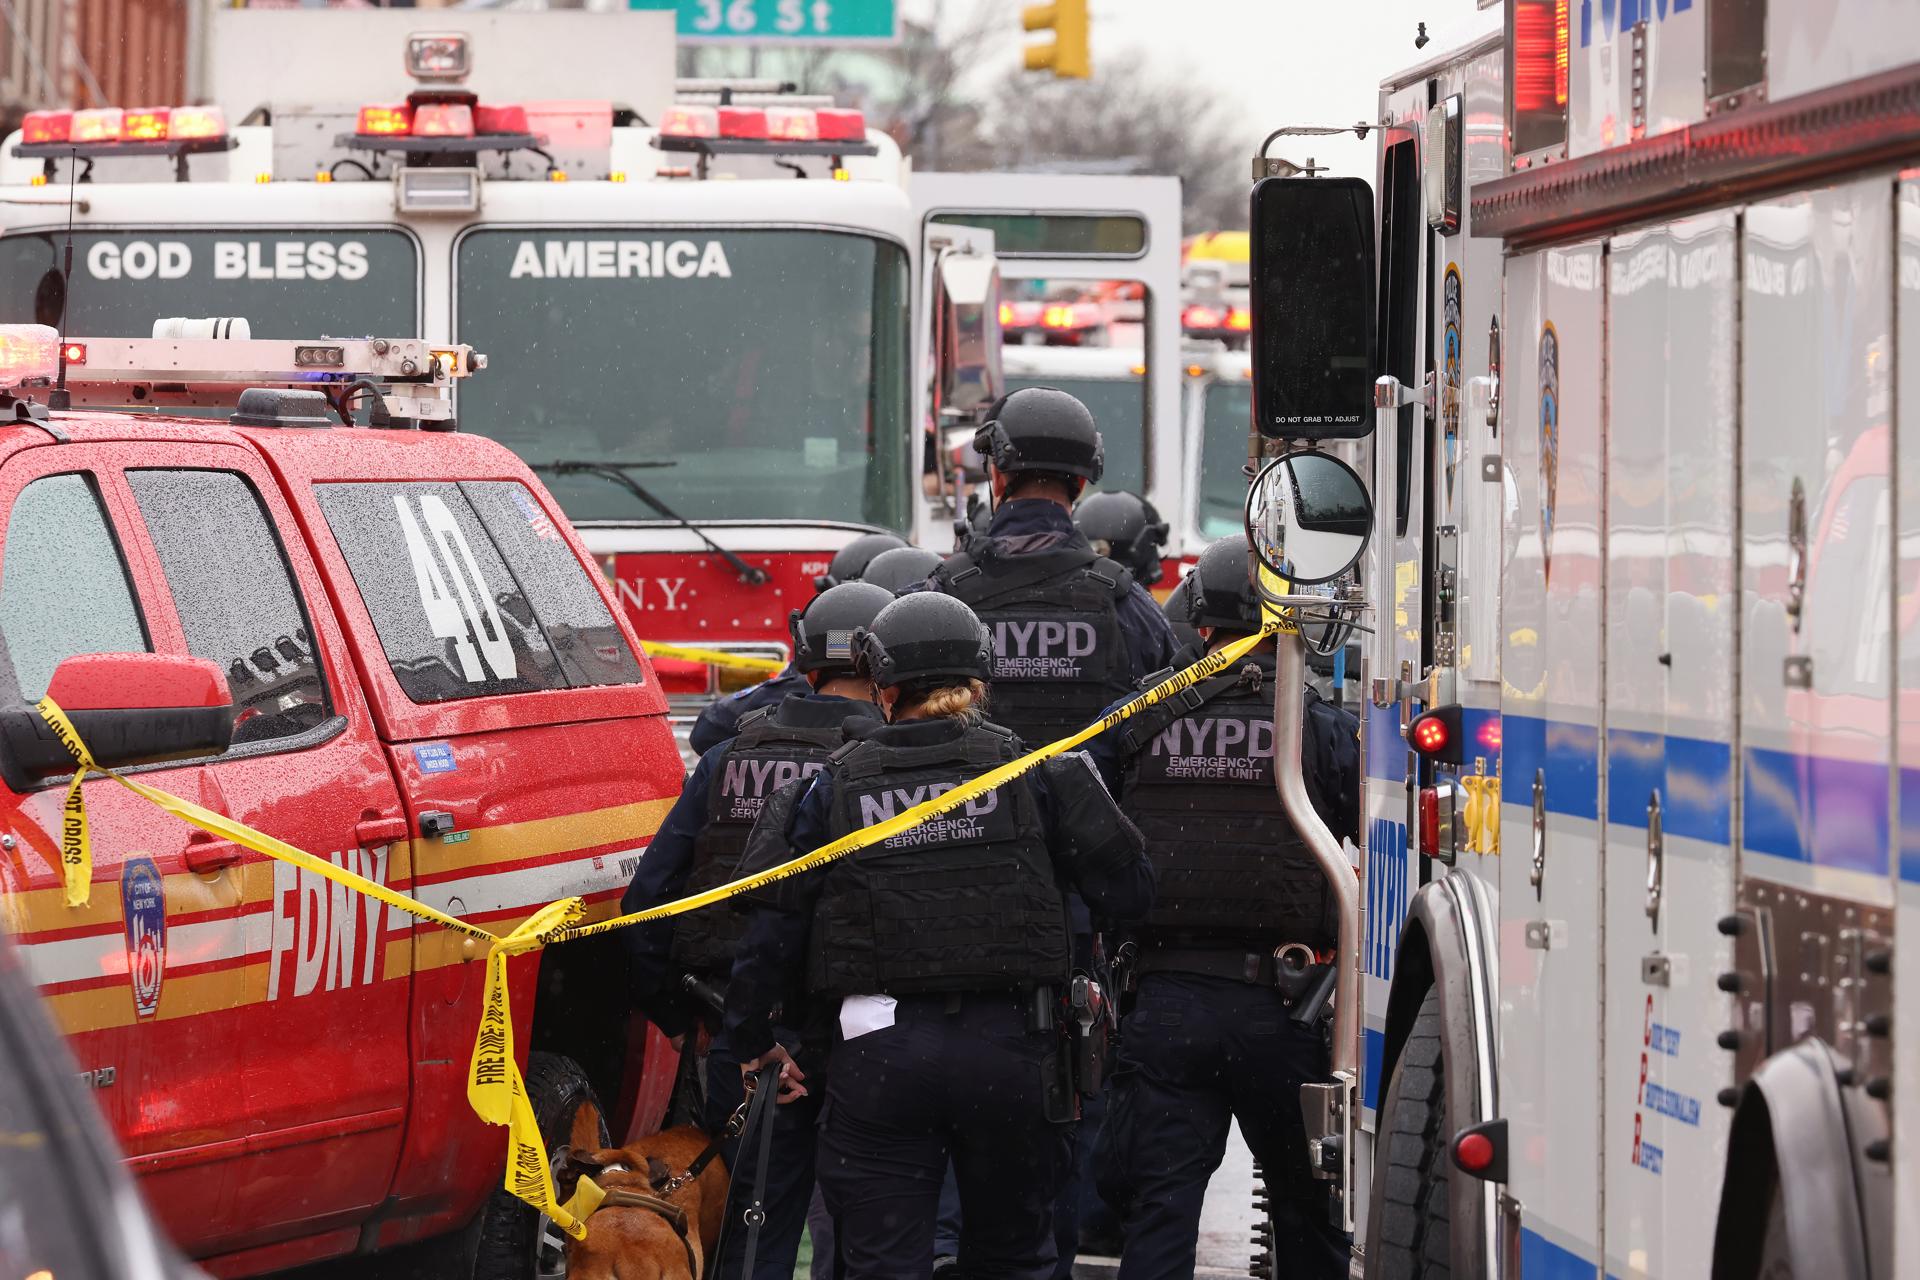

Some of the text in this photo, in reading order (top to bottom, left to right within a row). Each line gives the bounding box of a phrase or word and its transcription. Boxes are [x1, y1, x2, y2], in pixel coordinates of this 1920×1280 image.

[694, 0, 832, 32] 36 St
[87, 241, 369, 280] GOD BLESS
[509, 240, 732, 278] AMERICA
[1324, 415, 1333, 423] TO
[393, 495, 518, 683] 40
[994, 667, 1082, 678] SERVICE UNIT
[997, 657, 1077, 668] EMERGENCY
[1151, 718, 1275, 758] NYPD
[1165, 766, 1263, 780] SERVICE UNIT
[1169, 756, 1258, 769] EMERGENCY
[884, 826, 985, 849] SERVICE UNIT
[888, 817, 977, 840] MERGENCY
[134, 884, 145, 895] CITY
[133, 897, 156, 910] NEW YORK
[267, 845, 388, 1002] FDNY
[476, 1056, 505, 1086] FIRE
